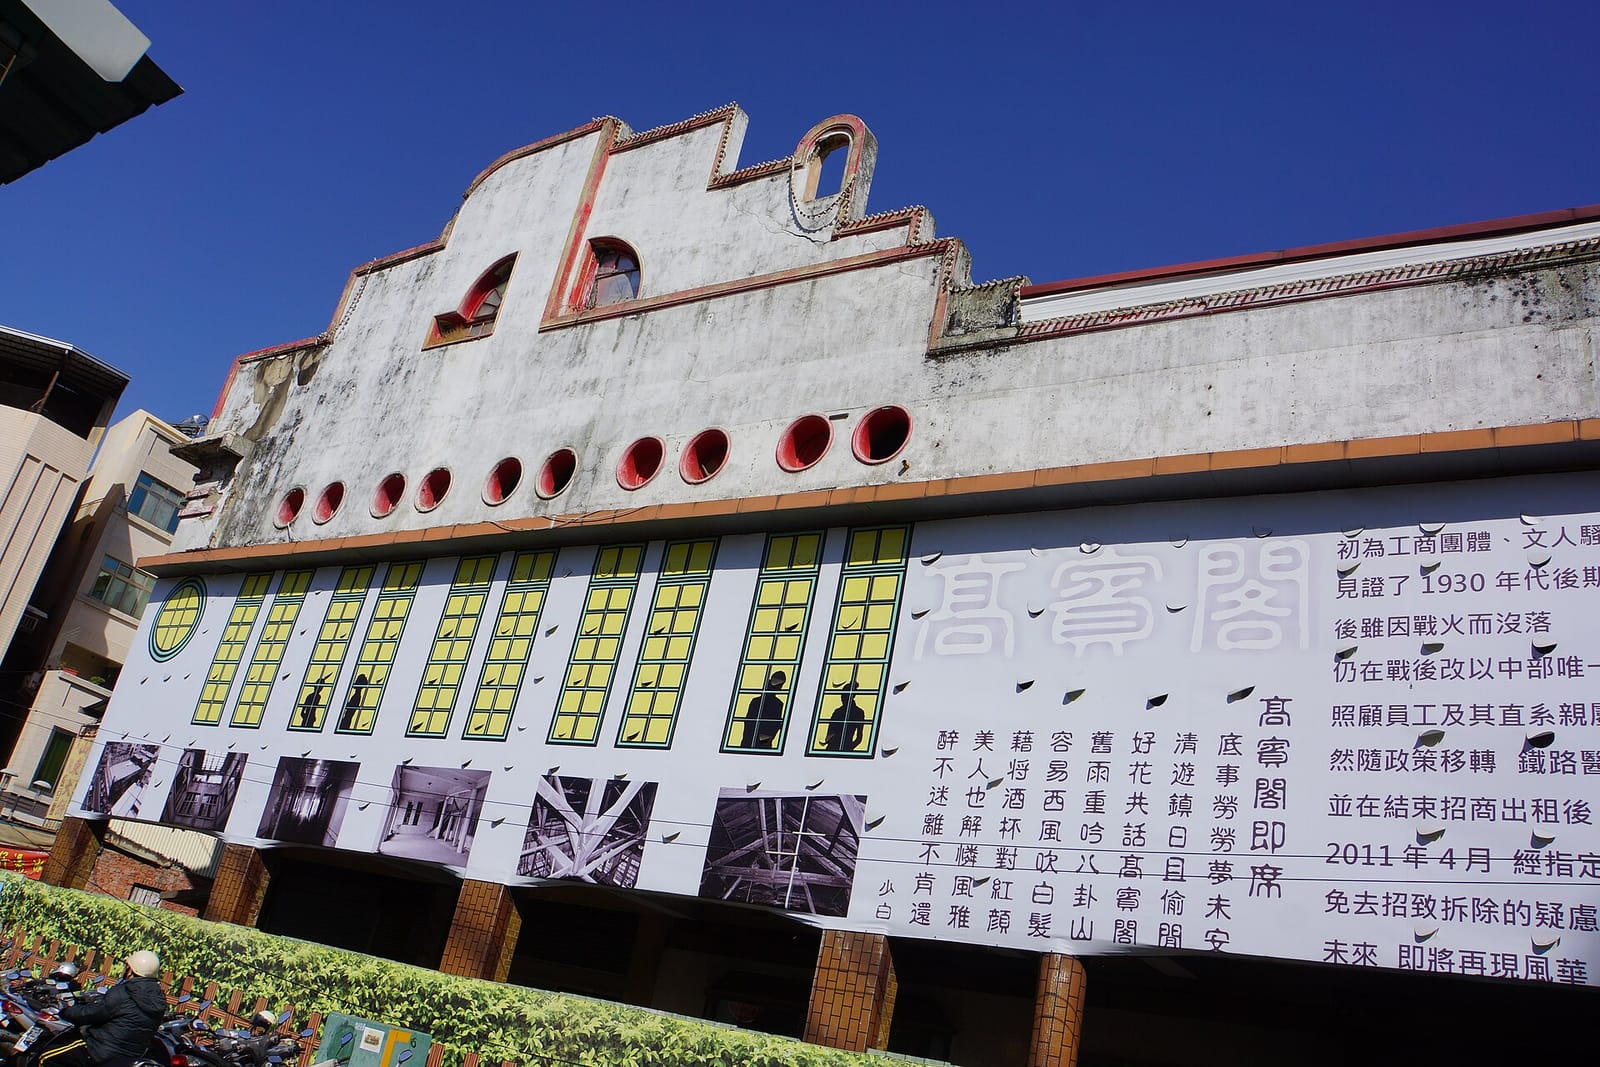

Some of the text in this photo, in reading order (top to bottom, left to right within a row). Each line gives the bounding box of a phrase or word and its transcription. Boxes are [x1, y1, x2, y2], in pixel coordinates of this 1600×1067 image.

[1336, 575, 1410, 600] 見證了
[1421, 573, 1486, 594] 1930
[1334, 610, 1552, 640] 後雖因戰火而沒落
[1329, 748, 1497, 774] 然隨政策移轉
[1327, 793, 1593, 825] 並在結束招商出租後
[908, 729, 960, 926] 醉不迷離不肯還
[1027, 730, 1073, 938] 容易西風吹白髮
[1070, 731, 1115, 941] 舊雨重吟八卦山
[1325, 842, 1394, 867] 2011
[1438, 847, 1456, 870] 4
[875, 879, 895, 920] 少白
[1324, 888, 1599, 932] 免去招致拆除的疑慮
[1323, 939, 1378, 967] 未來
